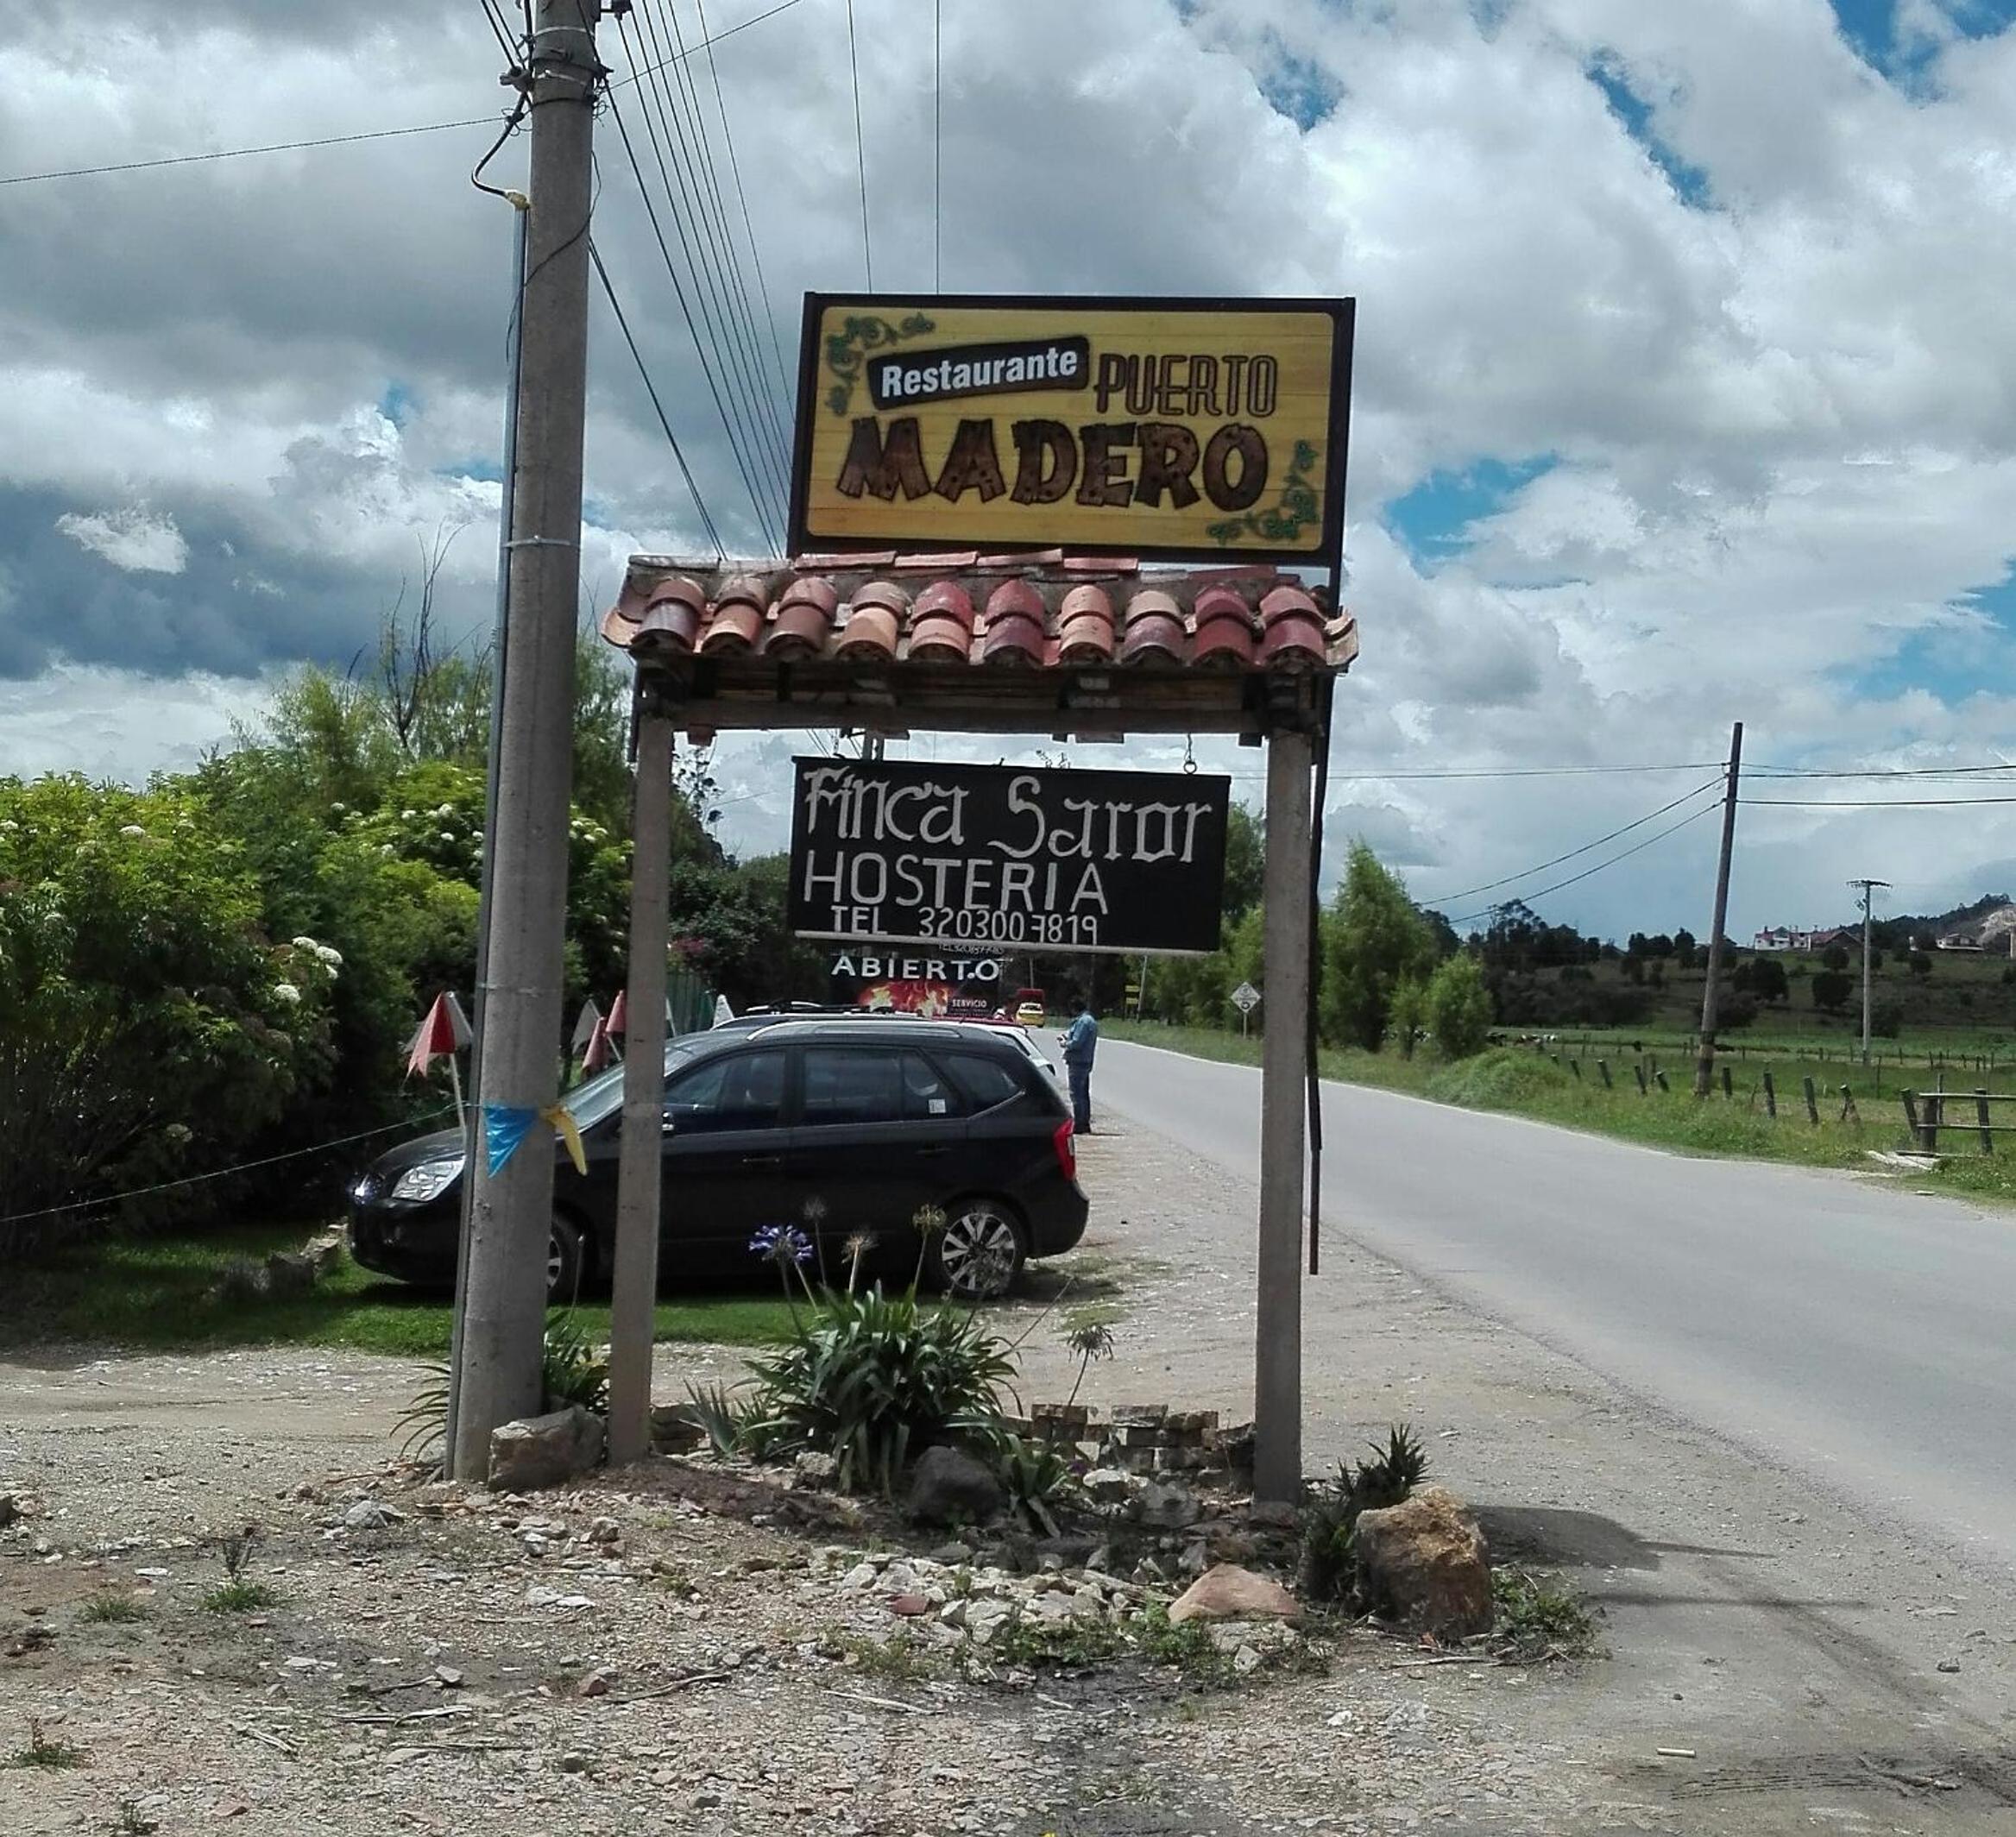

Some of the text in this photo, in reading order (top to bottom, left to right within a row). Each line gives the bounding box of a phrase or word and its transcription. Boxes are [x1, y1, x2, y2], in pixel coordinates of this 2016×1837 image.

[881, 347, 1277, 418] Restaurante PUERTO
[835, 416, 1269, 512] MADERO
[803, 765, 969, 846] Finca
[803, 849, 1108, 915] HOSTERIA
[830, 905, 888, 936] TEL
[831, 955, 1000, 981] ABIERTO
[952, 998, 987, 1008] SERVICIO
